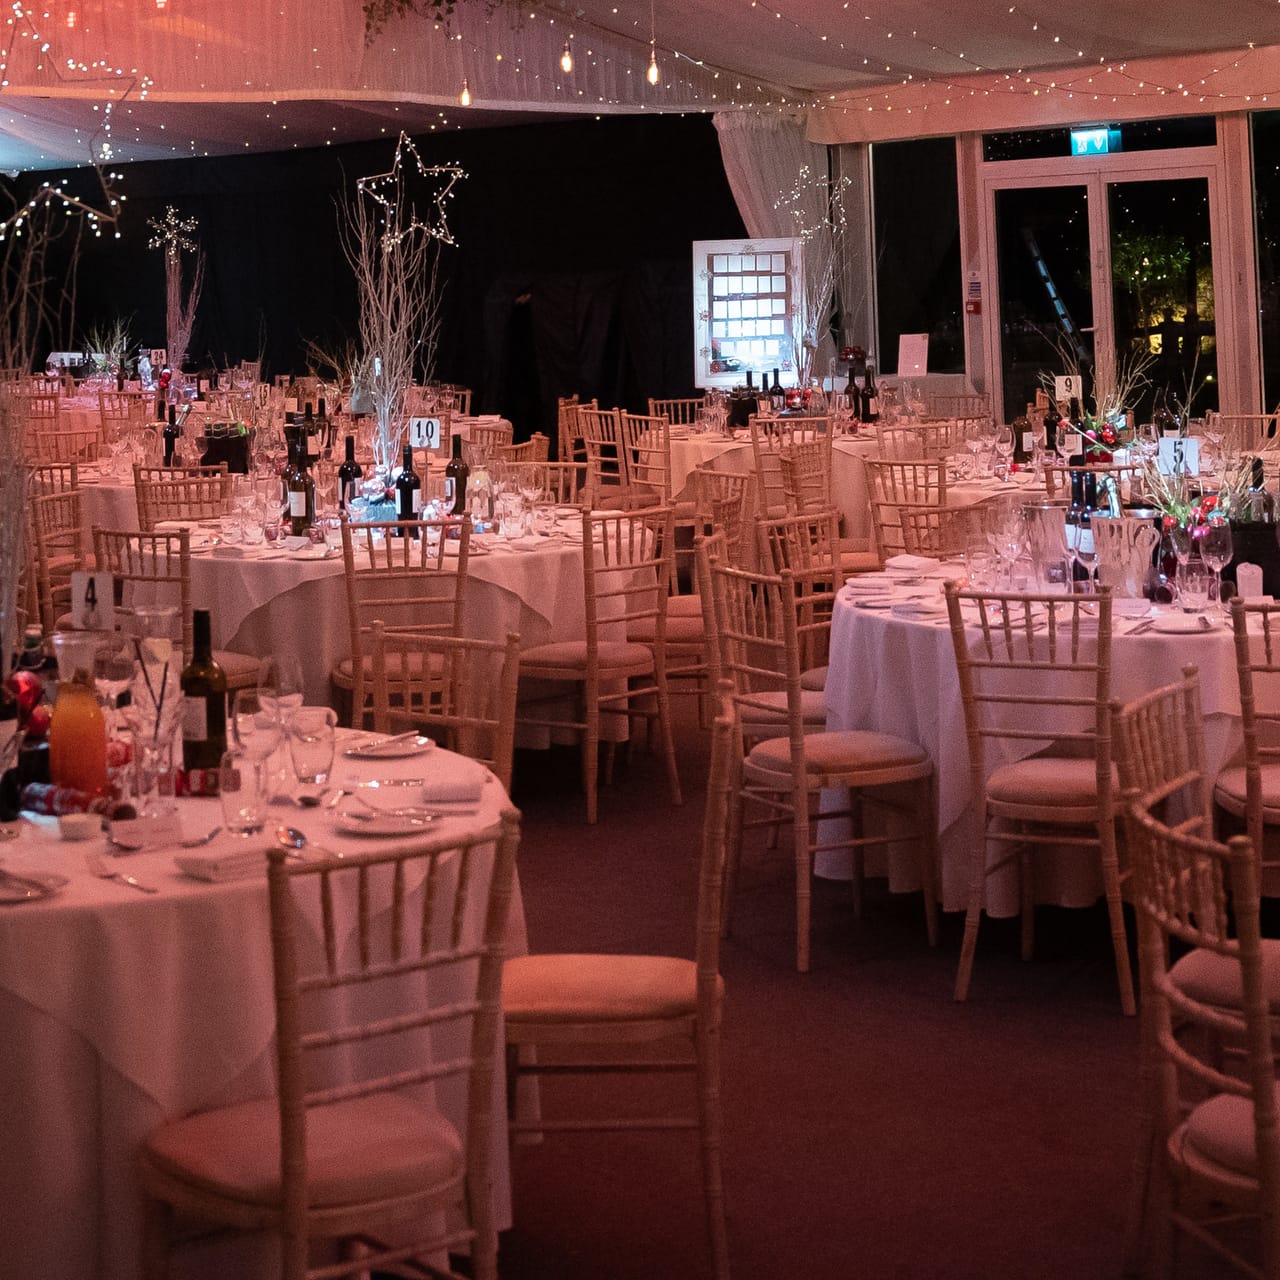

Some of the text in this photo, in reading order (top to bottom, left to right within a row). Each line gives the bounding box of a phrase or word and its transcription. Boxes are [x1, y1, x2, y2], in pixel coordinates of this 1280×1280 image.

[1065, 377, 1072, 393] 9
[416, 420, 434, 439] 10
[1173, 440, 1184, 464] 5
[85, 577, 97, 612] 4
